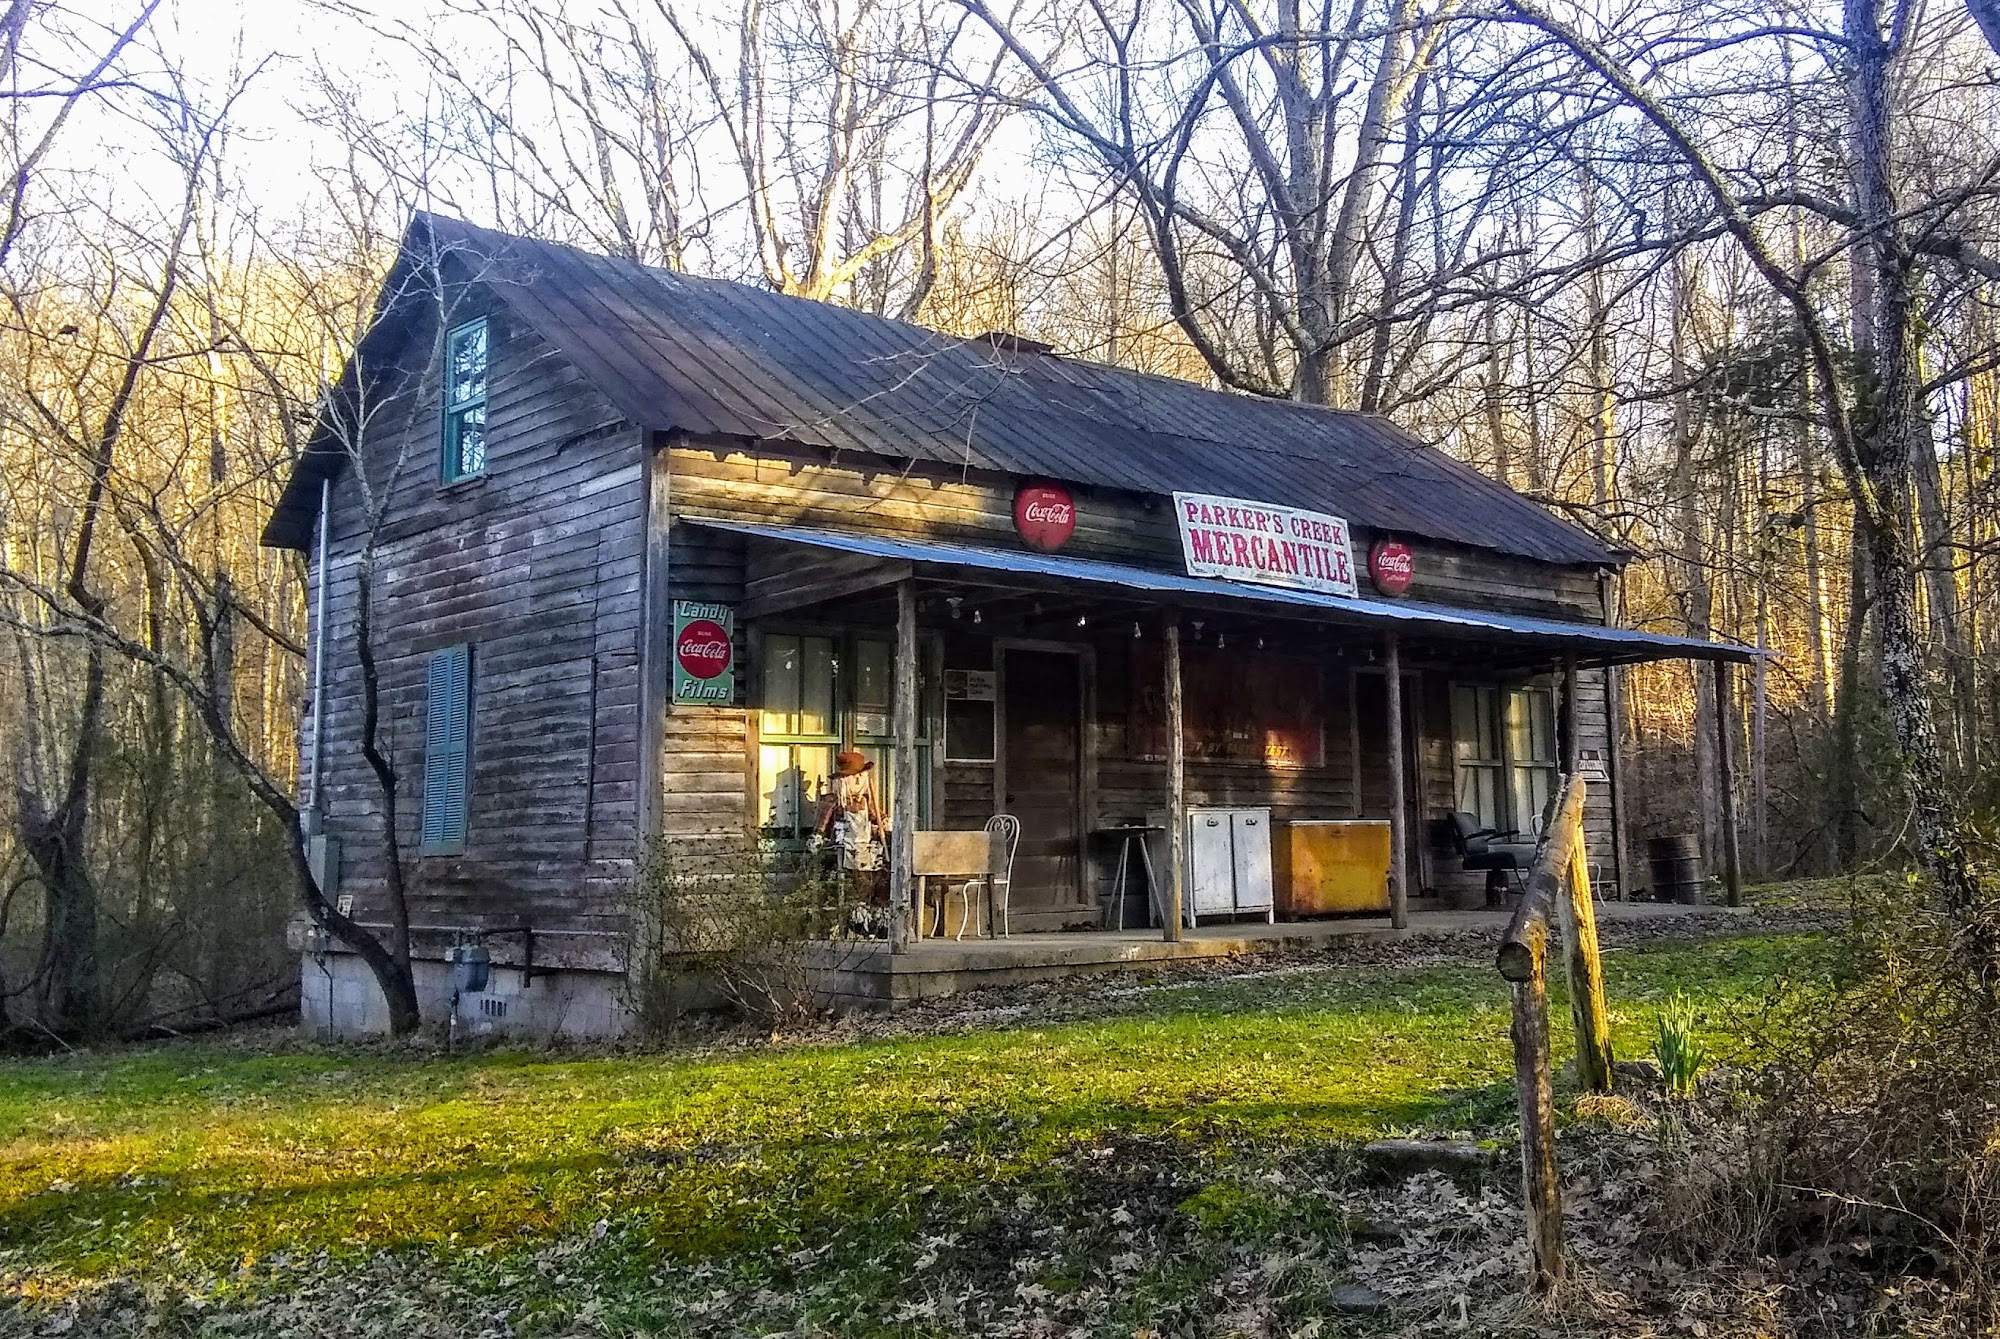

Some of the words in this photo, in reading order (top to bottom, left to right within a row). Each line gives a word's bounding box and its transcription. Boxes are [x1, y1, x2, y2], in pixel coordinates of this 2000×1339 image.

[1184, 501, 1284, 535] PARKER'S
[1290, 516, 1345, 546] CREEK
[1188, 528, 1350, 584] MERCANTILE
[680, 602, 728, 626] Candy
[680, 679, 728, 699] Films
